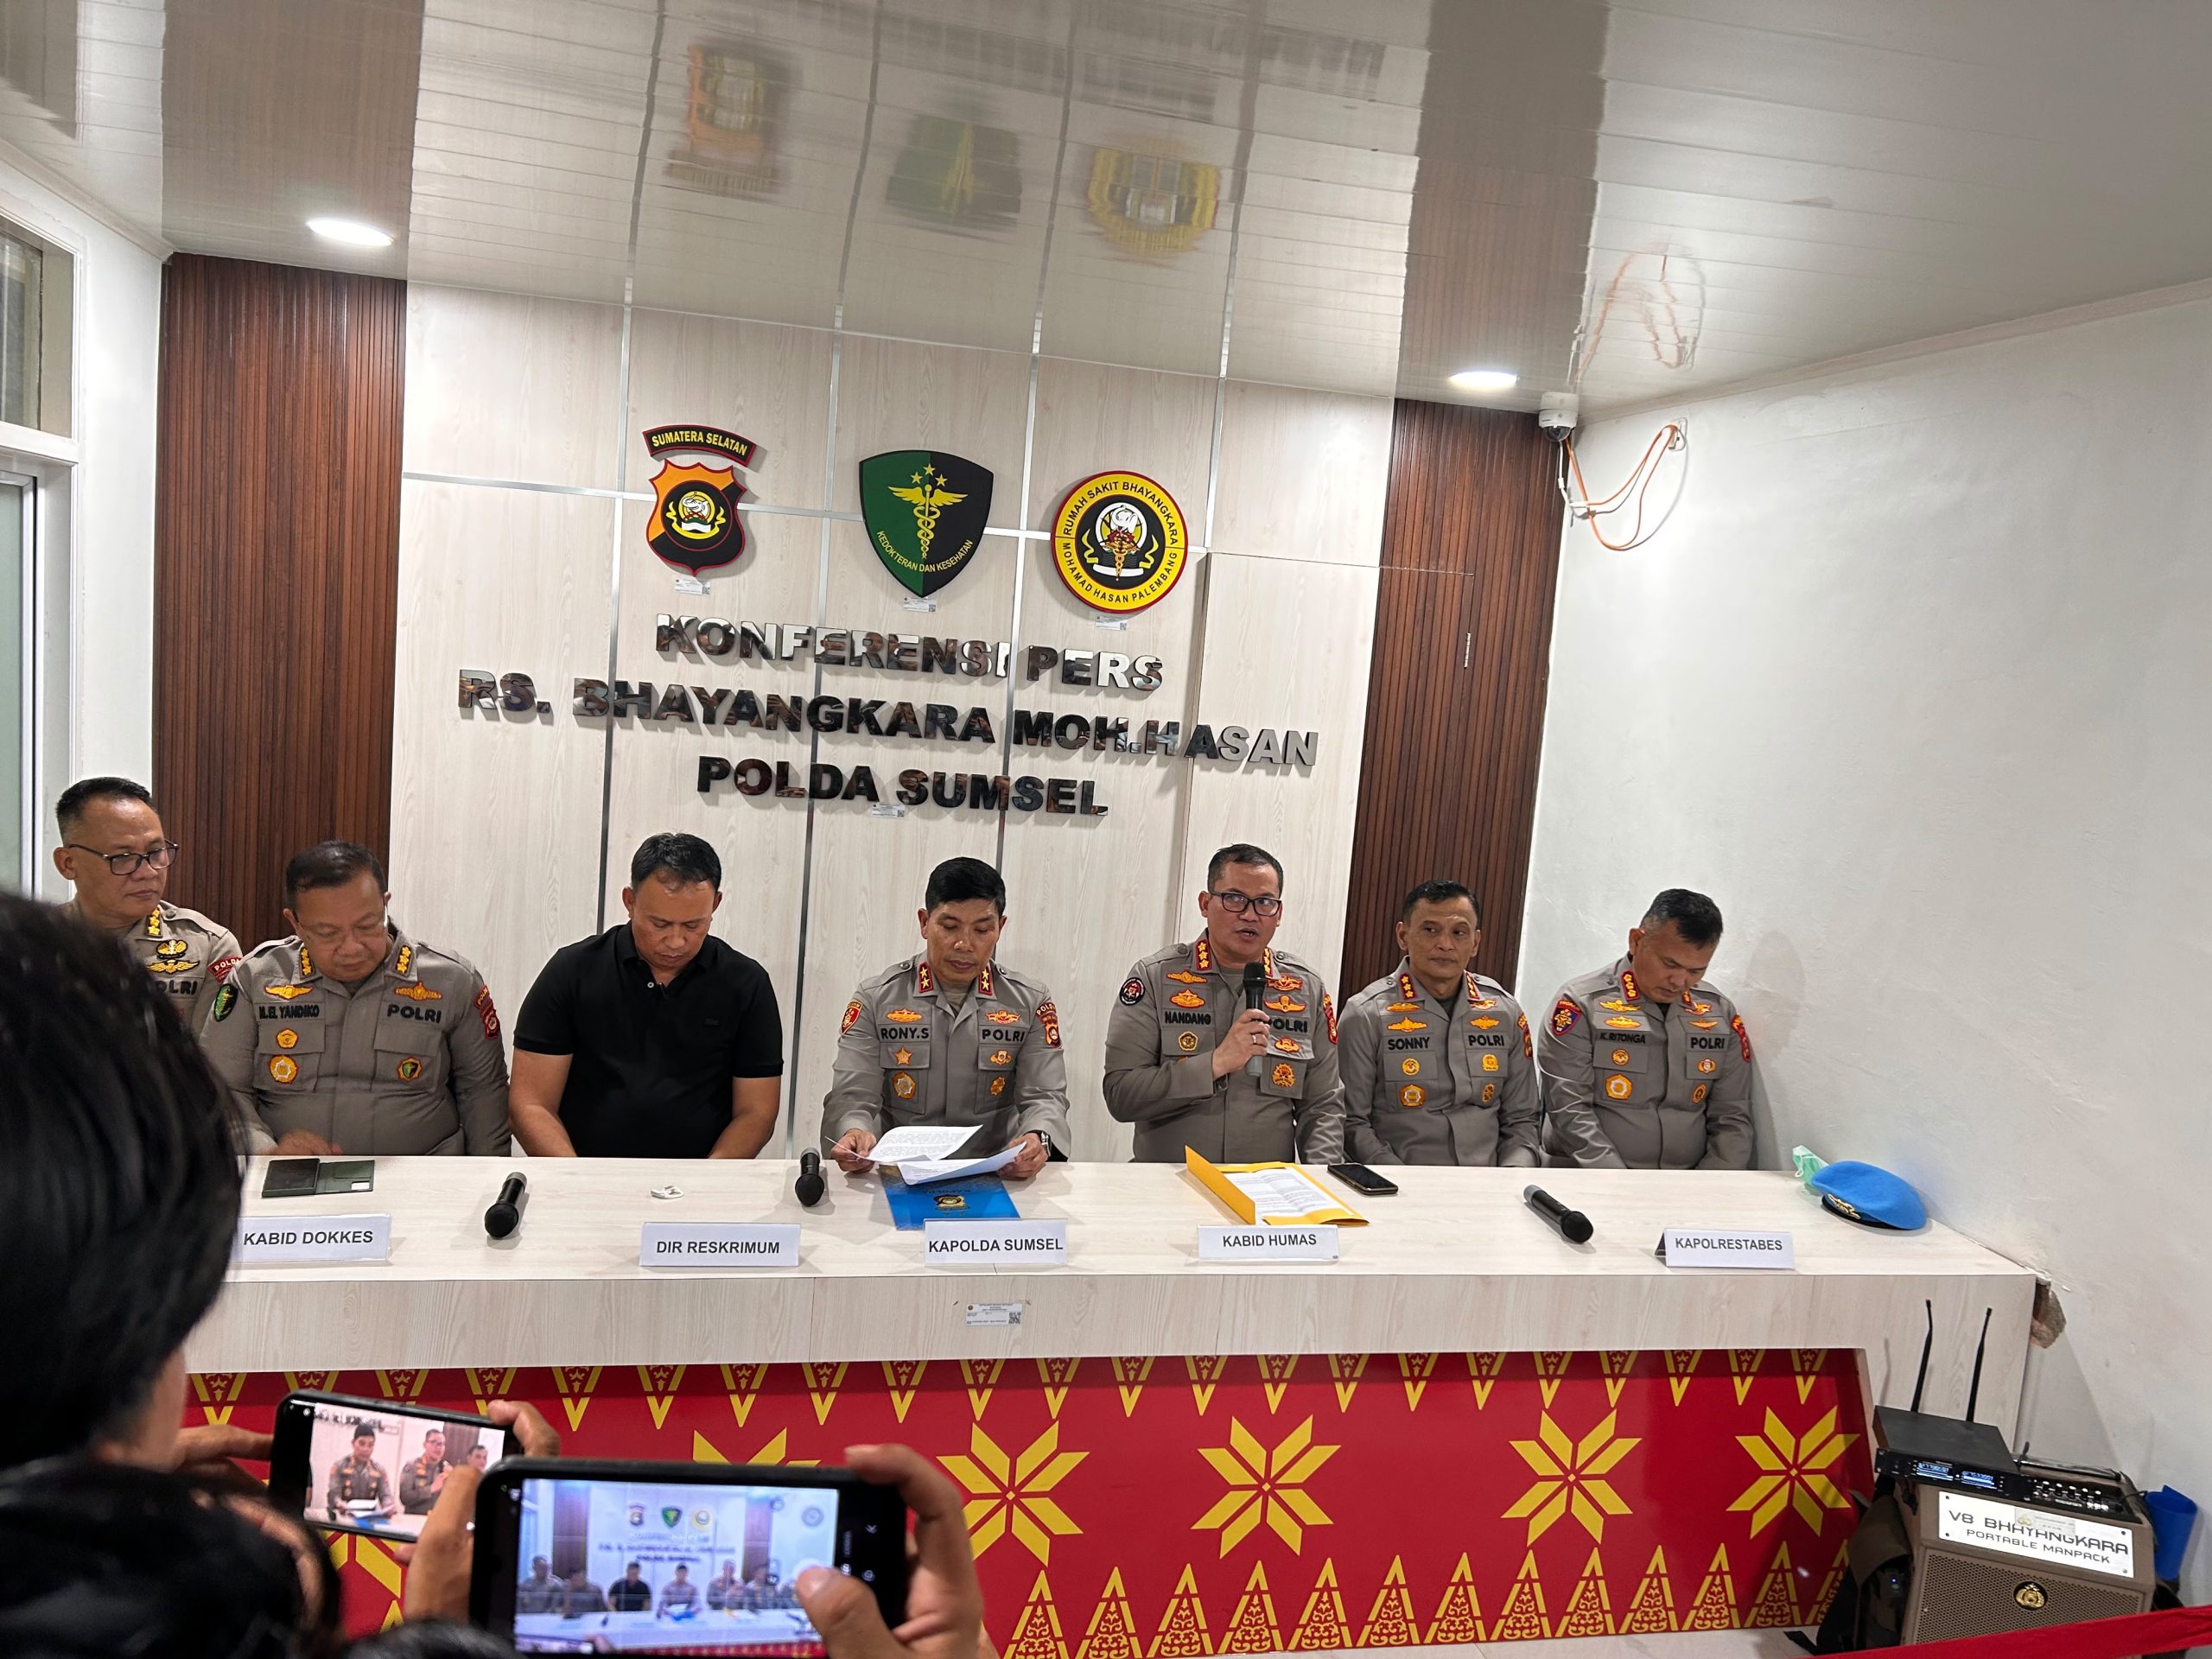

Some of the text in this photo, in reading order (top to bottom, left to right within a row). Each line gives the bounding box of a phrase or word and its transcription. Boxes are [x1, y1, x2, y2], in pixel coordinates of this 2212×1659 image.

[652, 431, 747, 456] SUMATERA SELATAN
[1063, 481, 1179, 545] RUMAH SAKIT BHAYANGKARA
[876, 531, 974, 573] KEDOKTERAN DAN KESEHATAN
[1063, 542, 1178, 603] MOHAMAD HASAN PALEMBANG
[655, 613, 1164, 691] KONFERENSI PERS
[457, 669, 550, 714] RS.
[572, 677, 995, 744] BHAYANGKARA
[696, 755, 1109, 817] POLDA SUMSEL
[155, 980, 198, 995] OLRI
[387, 1004, 442, 1023] POLRI
[1165, 1011, 1211, 1025] NANDANG
[880, 1027, 930, 1039] RONY.S
[982, 1028, 1026, 1042] POLRI
[1469, 1035, 1504, 1046] POLRI
[1388, 1037, 1431, 1051] SONNY
[1690, 1037, 1725, 1049] POLRI
[244, 1230, 373, 1246] KABID DOKKES
[928, 1237, 1064, 1253] KAPOLDA SUMSEL
[1223, 1234, 1317, 1247] KABID HUMAS
[1675, 1237, 1783, 1251] KAPOLRESTABES
[656, 1241, 780, 1255] DIR RESKRIMUM
[1948, 1510, 1974, 1525] V8
[1967, 1529, 2111, 1564] PORTABLE MANPACK
